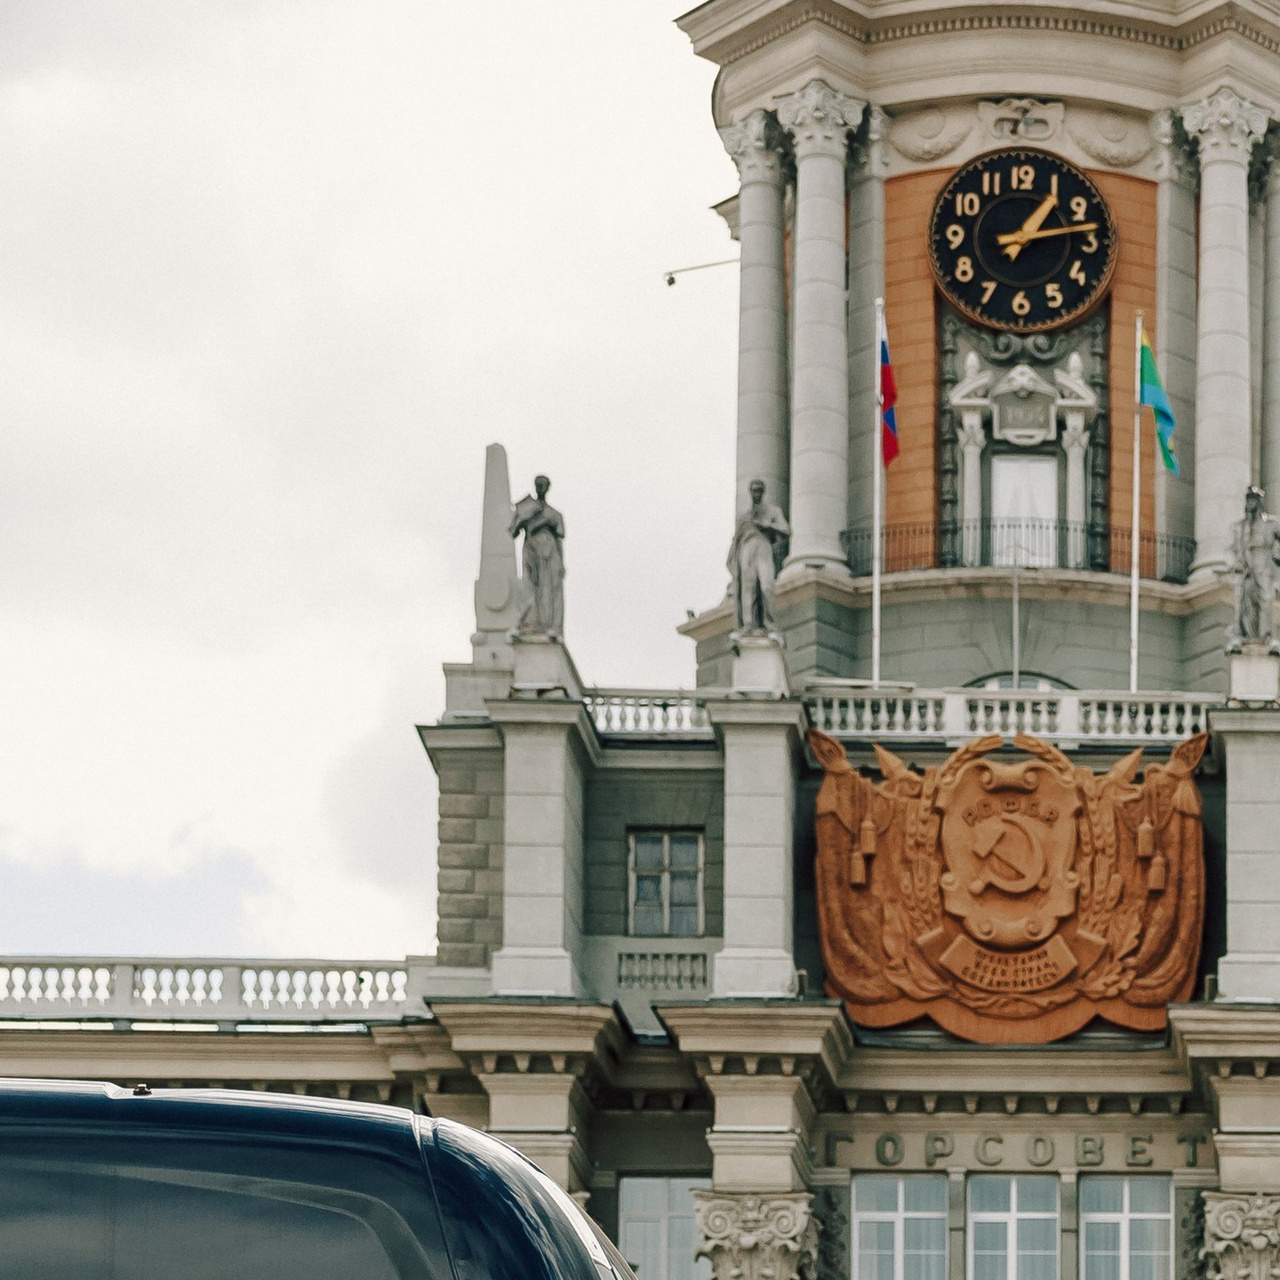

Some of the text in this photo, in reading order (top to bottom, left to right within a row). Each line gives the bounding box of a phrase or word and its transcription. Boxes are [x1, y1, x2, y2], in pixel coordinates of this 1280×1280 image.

[983, 171, 1000, 196] 11
[1011, 165, 1035, 190] 12
[955, 192, 980, 217] 10
[946, 224, 965, 250] 9
[955, 256, 974, 282] 8
[1069, 260, 1086, 286] 4
[981, 281, 997, 304] 7
[1012, 290, 1031, 315] 6
[1045, 283, 1063, 308] 5
[824, 1131, 1208, 1167] ГОРСОВЕТ
